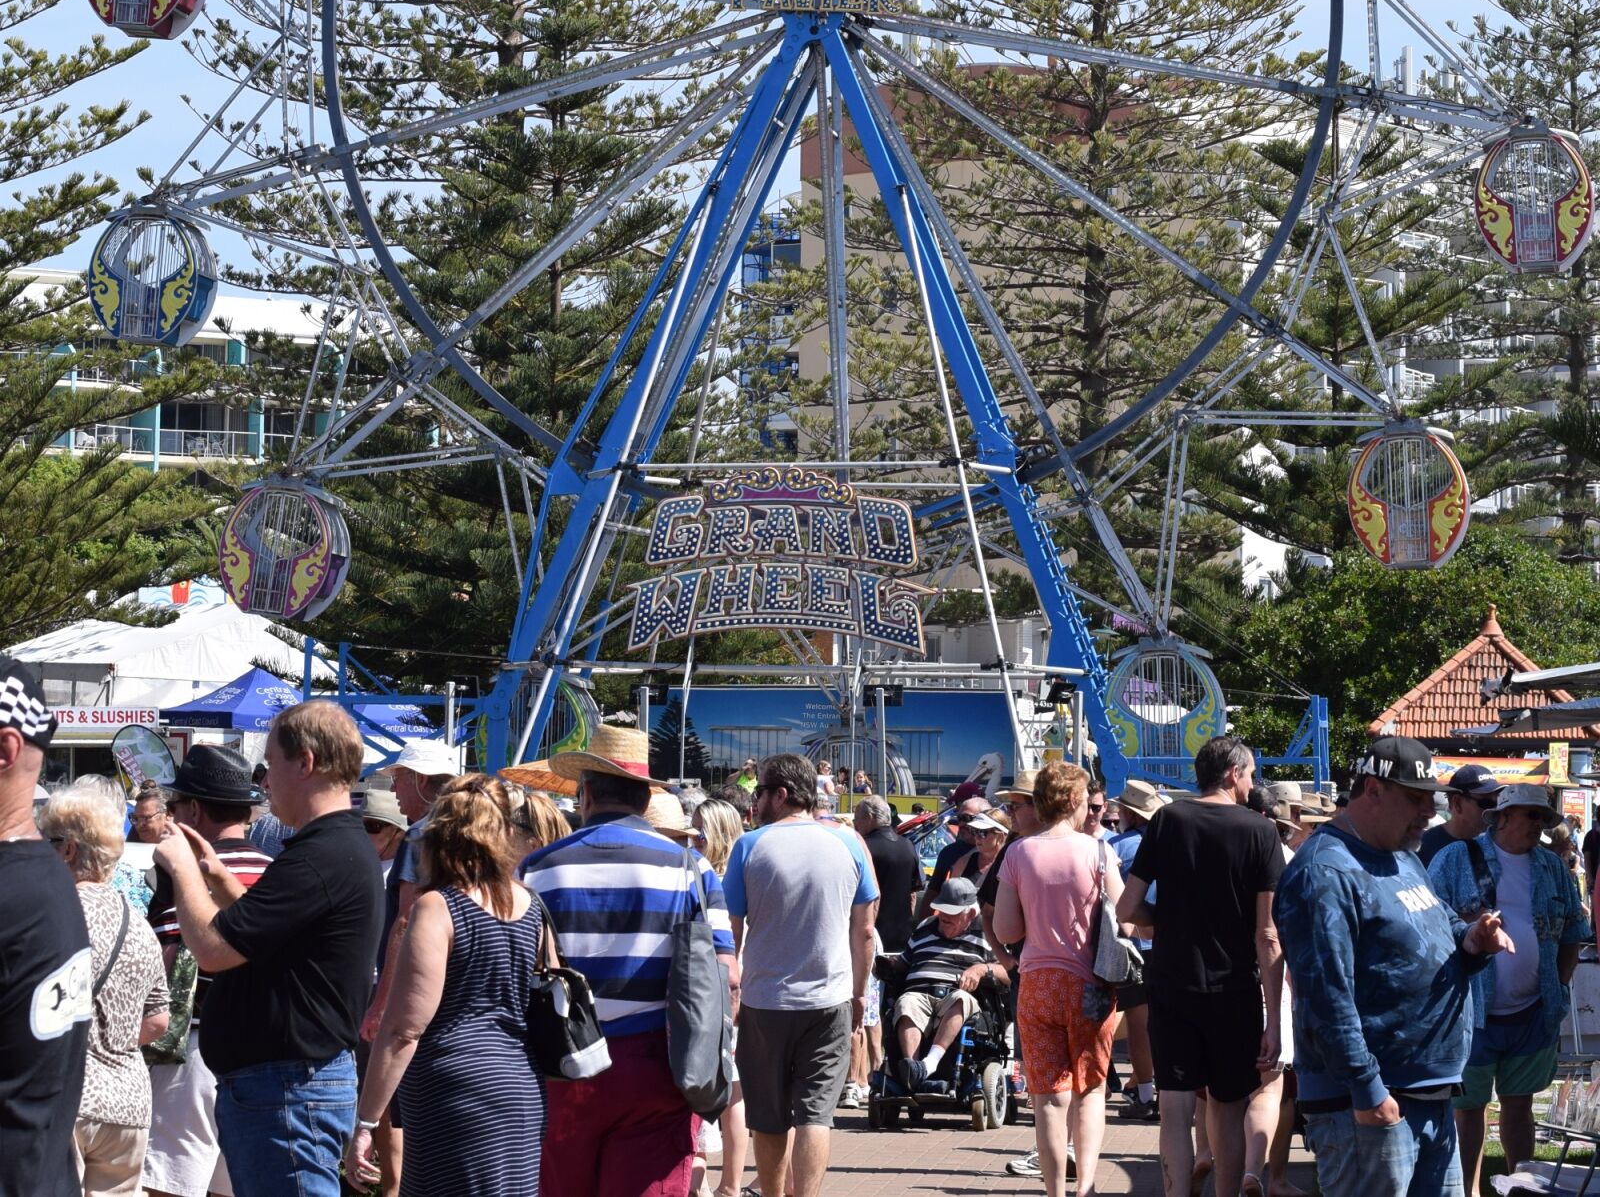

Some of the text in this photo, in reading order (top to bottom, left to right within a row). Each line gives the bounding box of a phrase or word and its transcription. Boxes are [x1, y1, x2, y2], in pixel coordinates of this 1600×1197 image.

[645, 494, 919, 570] GRAND
[626, 562, 938, 655] WHEEL
[256, 686, 292, 695] Central
[78, 710, 88, 723] &
[91, 710, 155, 723] SLUSHIES
[1396, 885, 1440, 912] RAW
